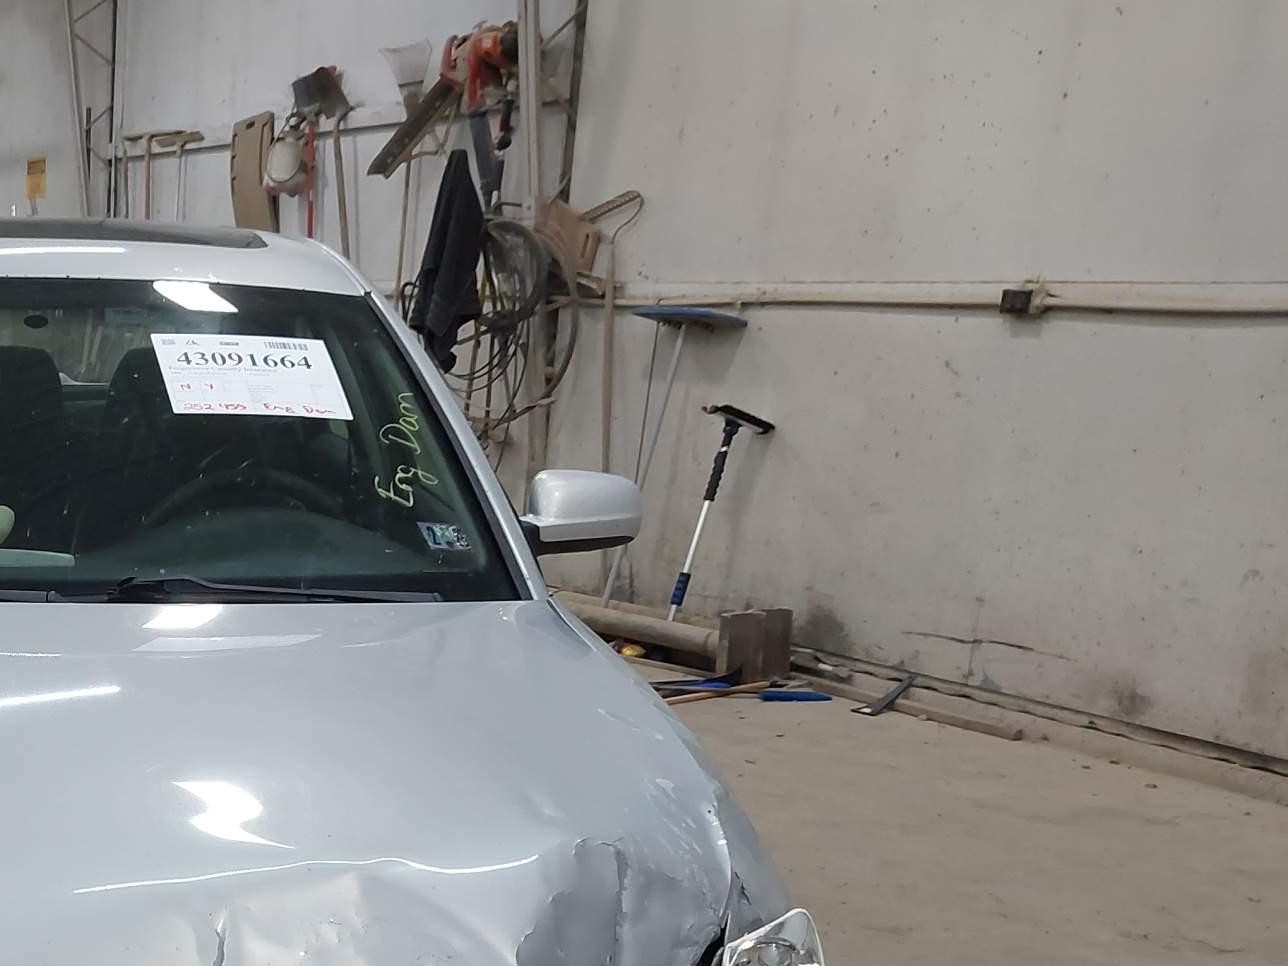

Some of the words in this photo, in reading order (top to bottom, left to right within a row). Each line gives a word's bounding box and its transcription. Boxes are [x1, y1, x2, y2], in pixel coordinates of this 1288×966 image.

[176, 351, 313, 370] 43091664
[379, 392, 421, 455] Dam
[374, 464, 440, 508] Eng
